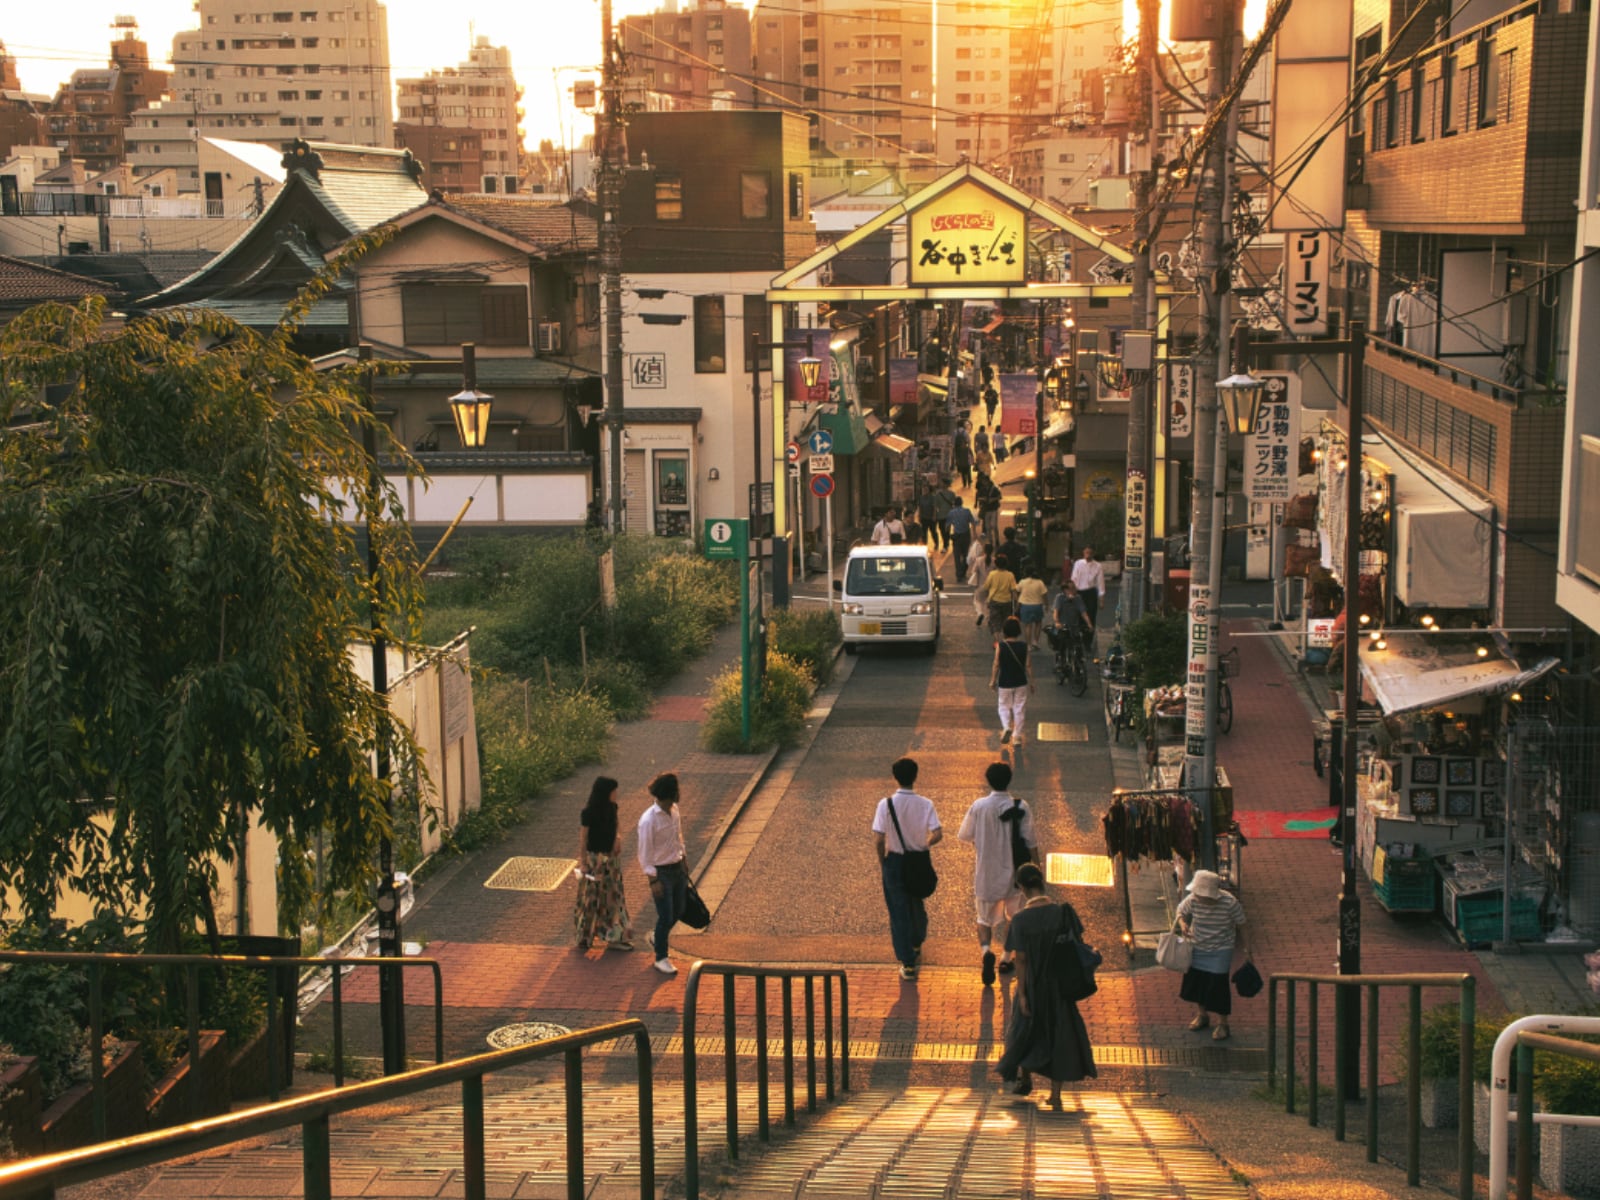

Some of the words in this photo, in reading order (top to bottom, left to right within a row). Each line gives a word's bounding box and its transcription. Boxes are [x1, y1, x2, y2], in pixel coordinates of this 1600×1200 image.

[919, 226, 1017, 275] 谷中ぎんざ
[1255, 404, 1271, 476] クリニック
